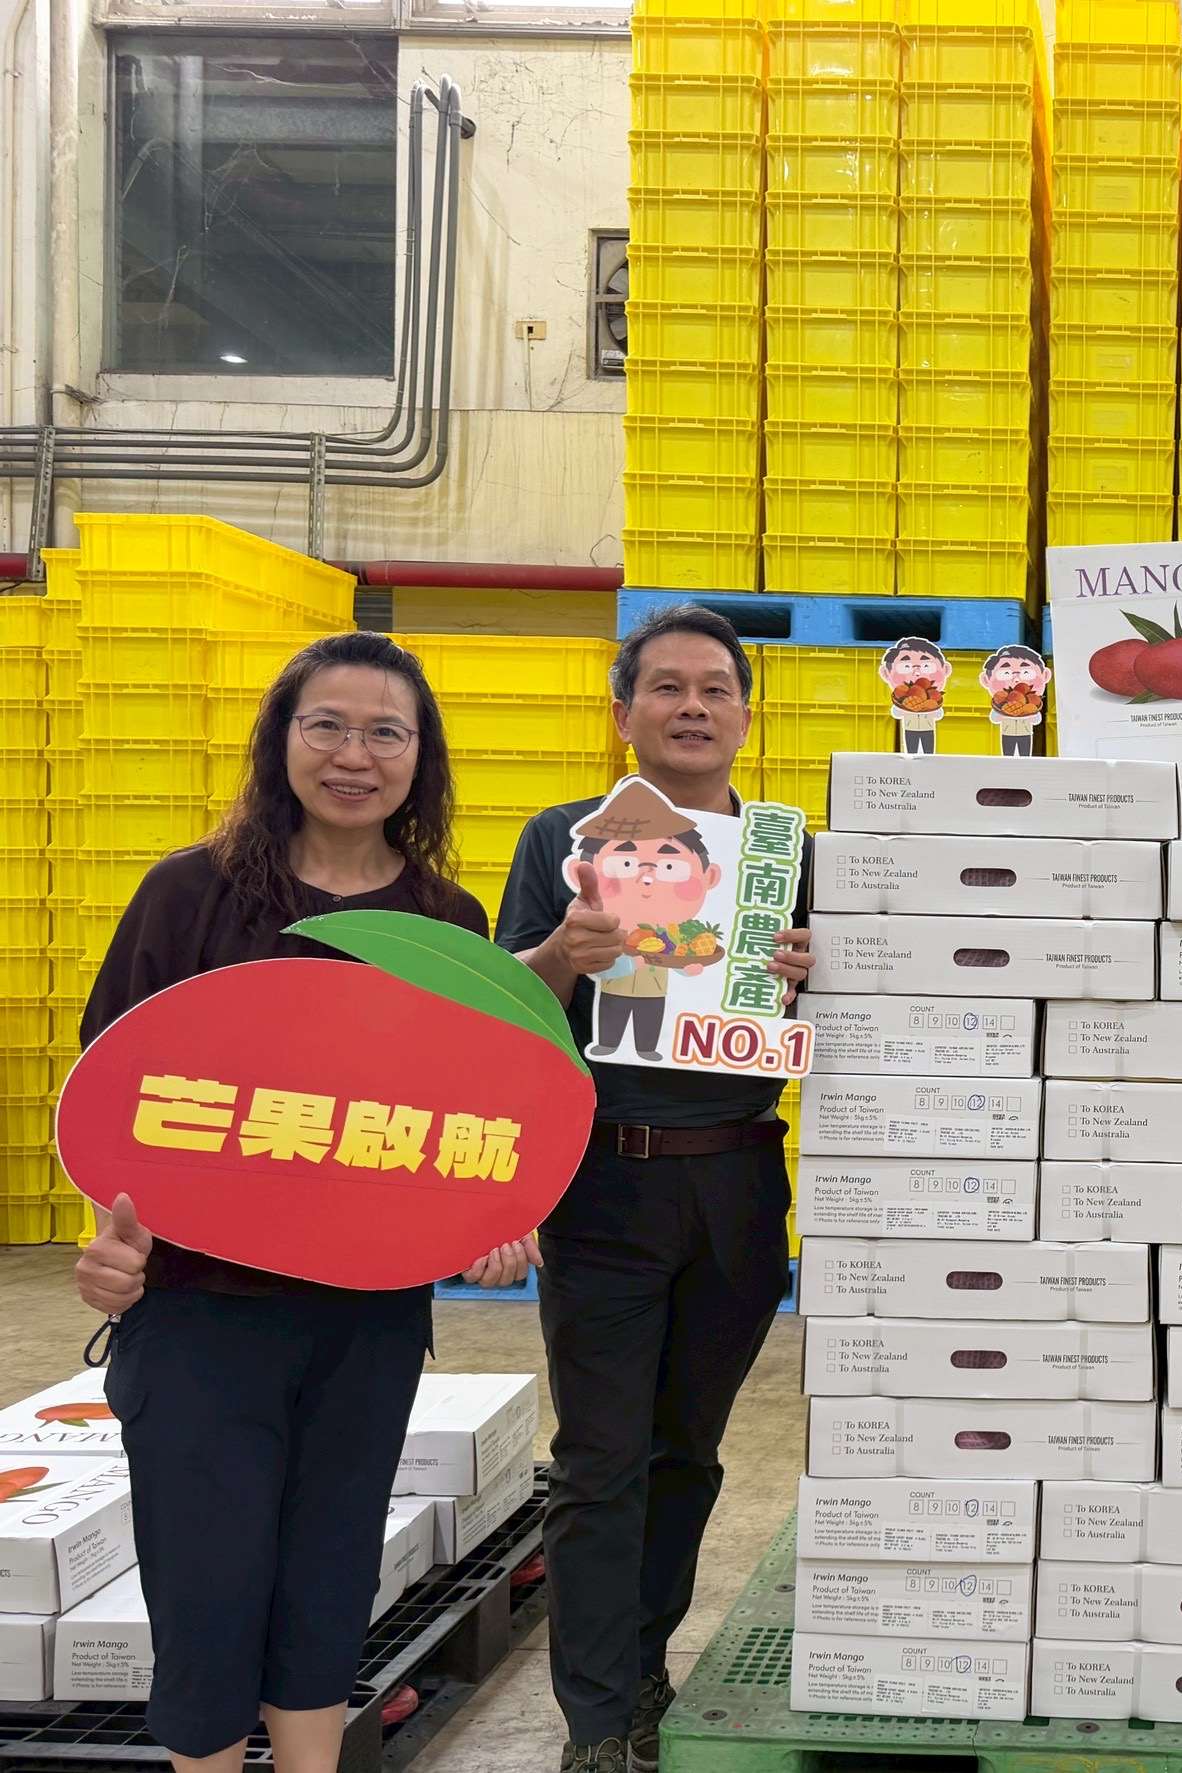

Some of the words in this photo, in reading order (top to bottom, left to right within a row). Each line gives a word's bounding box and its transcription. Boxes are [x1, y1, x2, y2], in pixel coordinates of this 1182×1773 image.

[866, 776, 876, 784] To
[880, 777, 911, 785] KOREA
[900, 790, 935, 798] Zealand
[1068, 794, 1088, 802] TAIWAN
[1089, 794, 1105, 802] FINEST
[1107, 794, 1134, 803] PRODUCTS
[879, 802, 916, 810] Australia
[849, 856, 860, 864] To
[862, 856, 894, 864] KOREA
[849, 868, 860, 876] To
[884, 870, 918, 878] Zealand
[849, 880, 859, 888] To
[862, 881, 899, 890] Australia
[729, 811, 795, 1011] 臺南農產
[1046, 954, 1065, 962] TAIWAN
[1066, 954, 1082, 962] FINEST
[1084, 954, 1111, 963] PRODUCTS
[1080, 1021, 1090, 1029] To
[1093, 1022, 1125, 1030] KOREA
[679, 1018, 805, 1067] NO.1
[1080, 1033, 1090, 1041] To
[1114, 1034, 1148, 1043] Zealand
[1080, 1045, 1090, 1053] To
[1093, 1046, 1130, 1054] Australia
[845, 1094, 876, 1102] Mango
[1093, 1105, 1124, 1113] KOREA
[1114, 1118, 1148, 1126] Zealand
[132, 1075, 521, 1182] 芒果啟航
[1092, 1130, 1130, 1138] Australia
[836, 1260, 847, 1268] To
[850, 1261, 882, 1269] KOREA
[850, 1273, 868, 1281] New
[871, 1274, 906, 1282] Zealand
[849, 1286, 887, 1294] Australia
[1042, 1354, 1062, 1362] TAIWAN
[1063, 1355, 1079, 1363] FINEST
[1081, 1355, 1108, 1364] PRODUCTS
[858, 1422, 890, 1430] KOREA
[858, 1434, 875, 1442] New
[879, 1434, 913, 1443] Zealand
[857, 1446, 895, 1455] Australia
[816, 1498, 838, 1506] Irwin
[840, 1499, 870, 1508] Mango
[1088, 1505, 1120, 1513] KOREA
[1088, 1518, 1106, 1526] New
[1110, 1518, 1144, 1527] Zealand
[1088, 1530, 1126, 1538] Australia
[73, 1640, 95, 1648] Irwin
[97, 1641, 128, 1650] Mango
[72, 1652, 99, 1660] Product
[101, 1652, 108, 1660] of
[809, 1652, 831, 1660] Irwin
[833, 1653, 864, 1662] Mango
[1066, 1662, 1076, 1670] To
[1079, 1663, 1110, 1671] KOREA
[1079, 1675, 1096, 1683] New
[1100, 1676, 1134, 1684] Zealand
[1078, 1687, 1116, 1696] Australia
